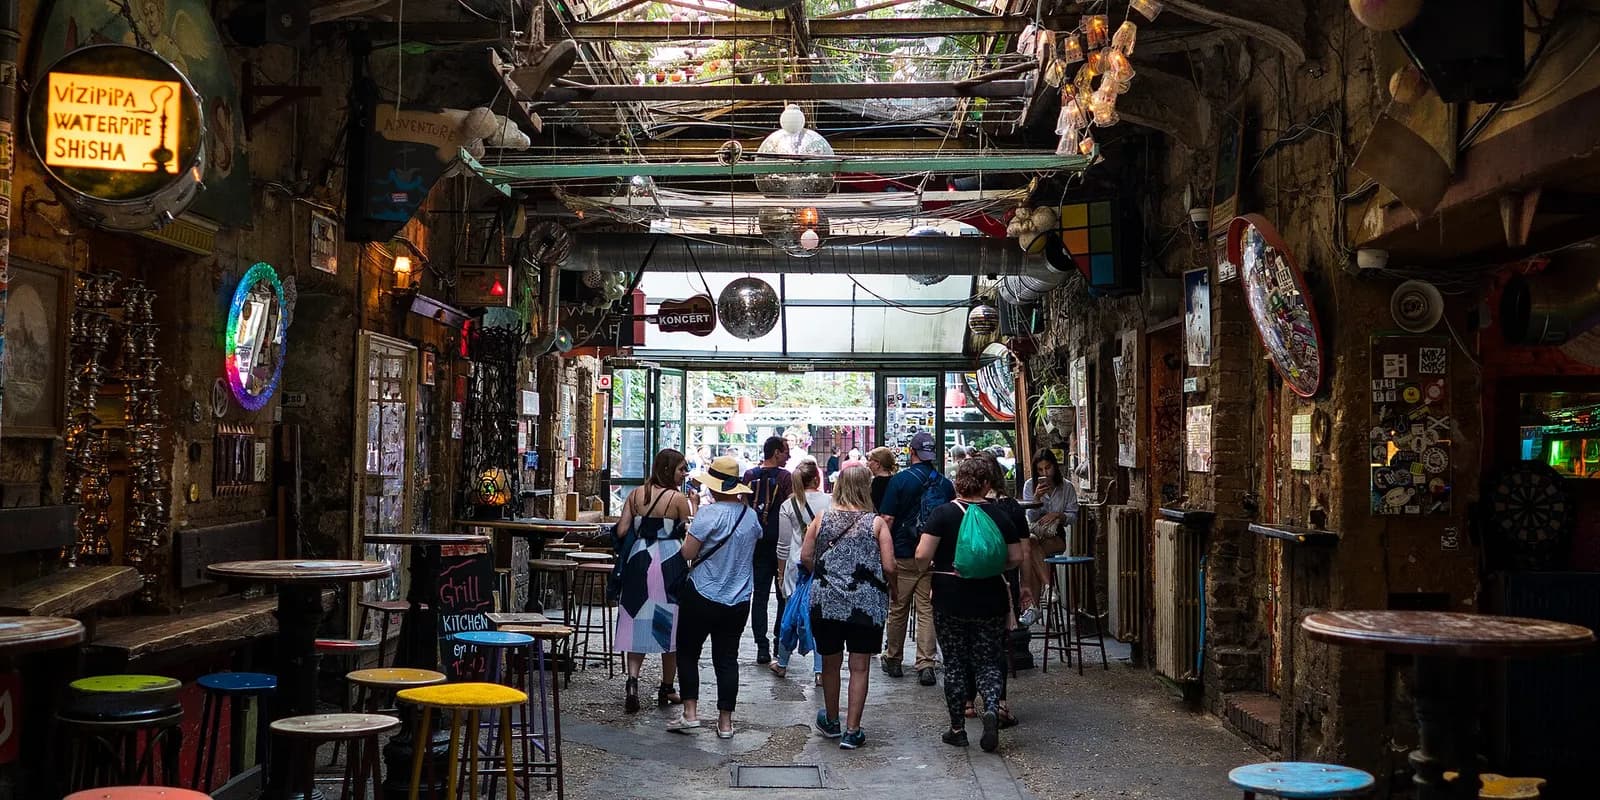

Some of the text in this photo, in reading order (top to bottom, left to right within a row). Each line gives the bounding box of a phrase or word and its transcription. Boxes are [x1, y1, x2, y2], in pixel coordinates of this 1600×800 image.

[384, 118, 456, 142] ADVENTURE
[659, 313, 710, 325] KONCERT
[440, 576, 480, 607] Grill
